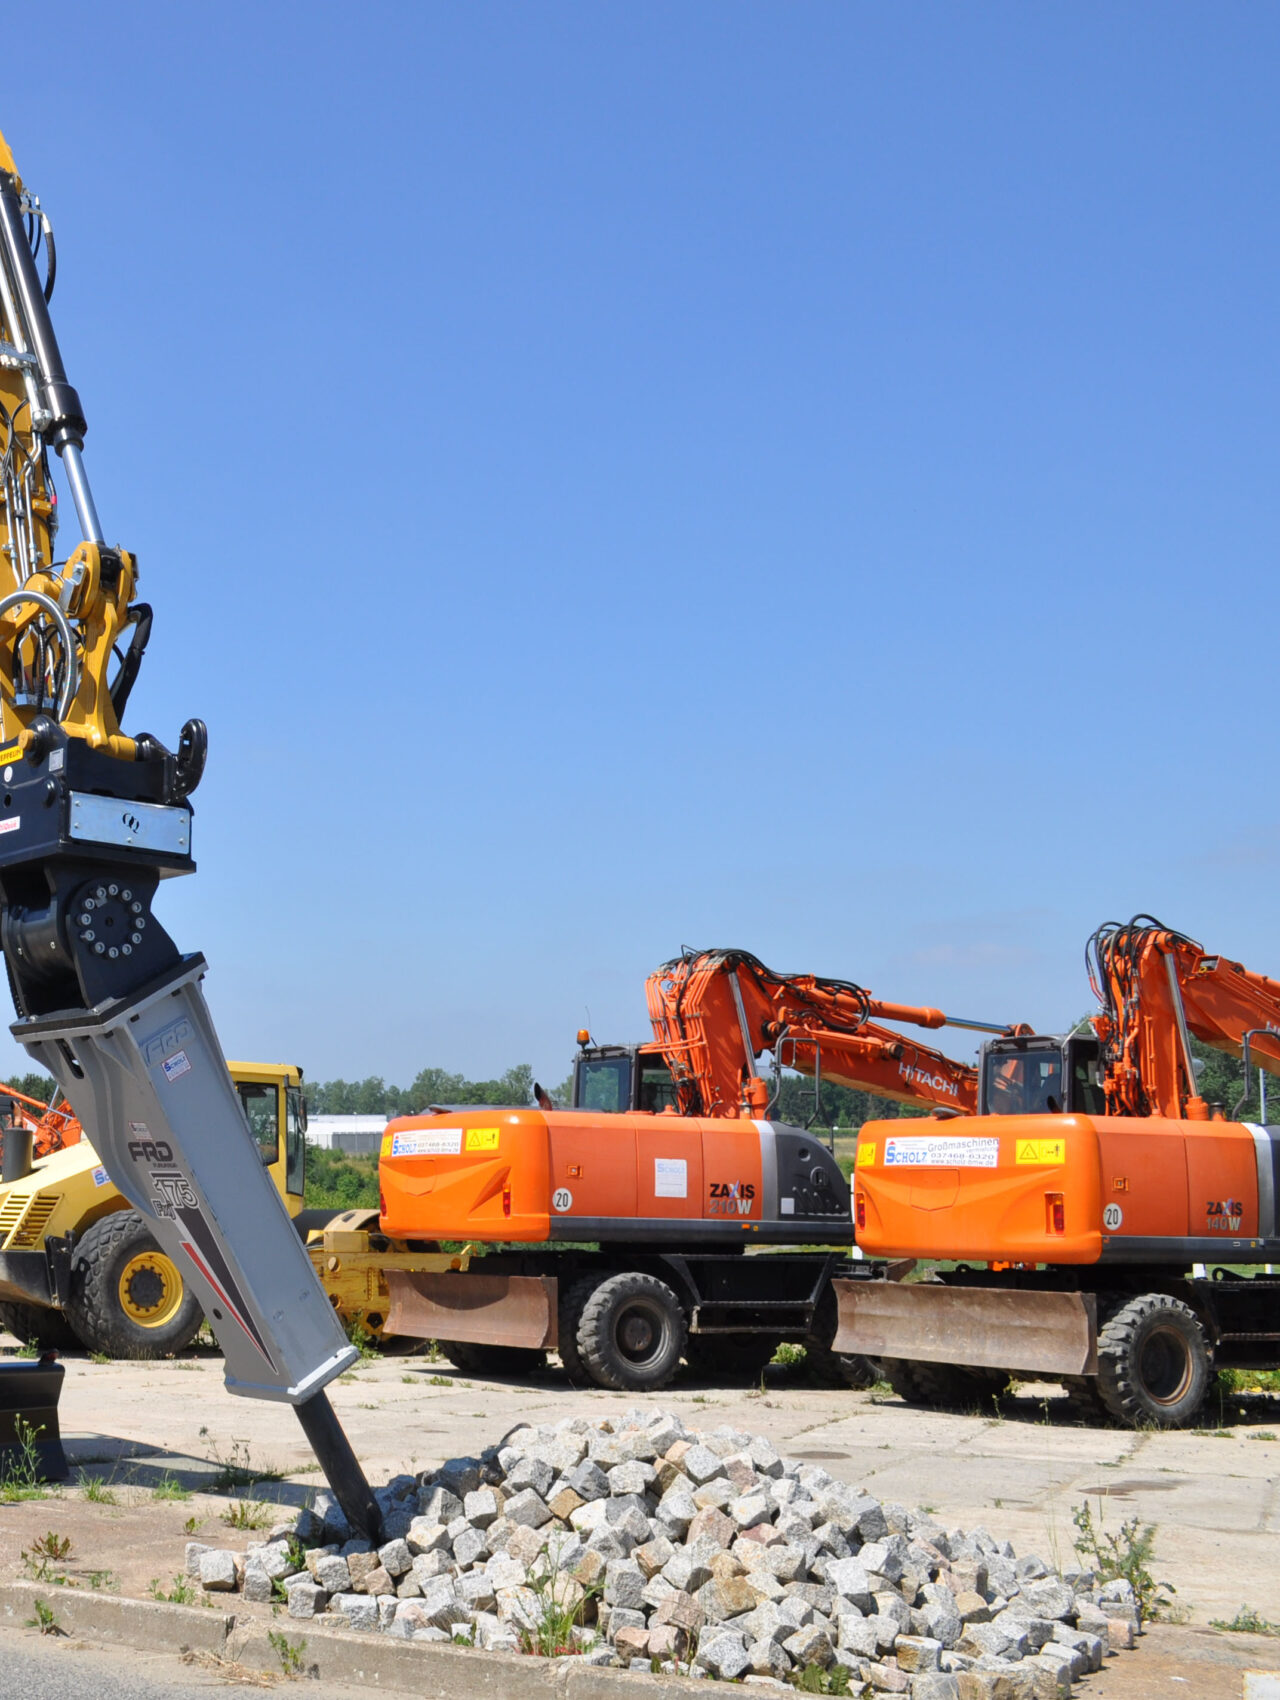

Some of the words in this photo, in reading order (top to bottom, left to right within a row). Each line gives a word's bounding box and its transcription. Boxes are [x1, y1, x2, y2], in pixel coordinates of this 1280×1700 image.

[898, 1061, 959, 1097] HITACHI
[128, 1141, 173, 1162] FRD
[927, 1137, 999, 1153] Großmaschinen
[885, 1145, 928, 1164] SCHOLZ
[153, 1178, 198, 1208] 175
[710, 1180, 756, 1199] ZAXIS
[556, 1192, 569, 1208] 20
[709, 1200, 753, 1215] 210W
[1206, 1198, 1244, 1216] ZAXIS
[1106, 1208, 1119, 1225] 20
[1206, 1216, 1242, 1231] 140W
